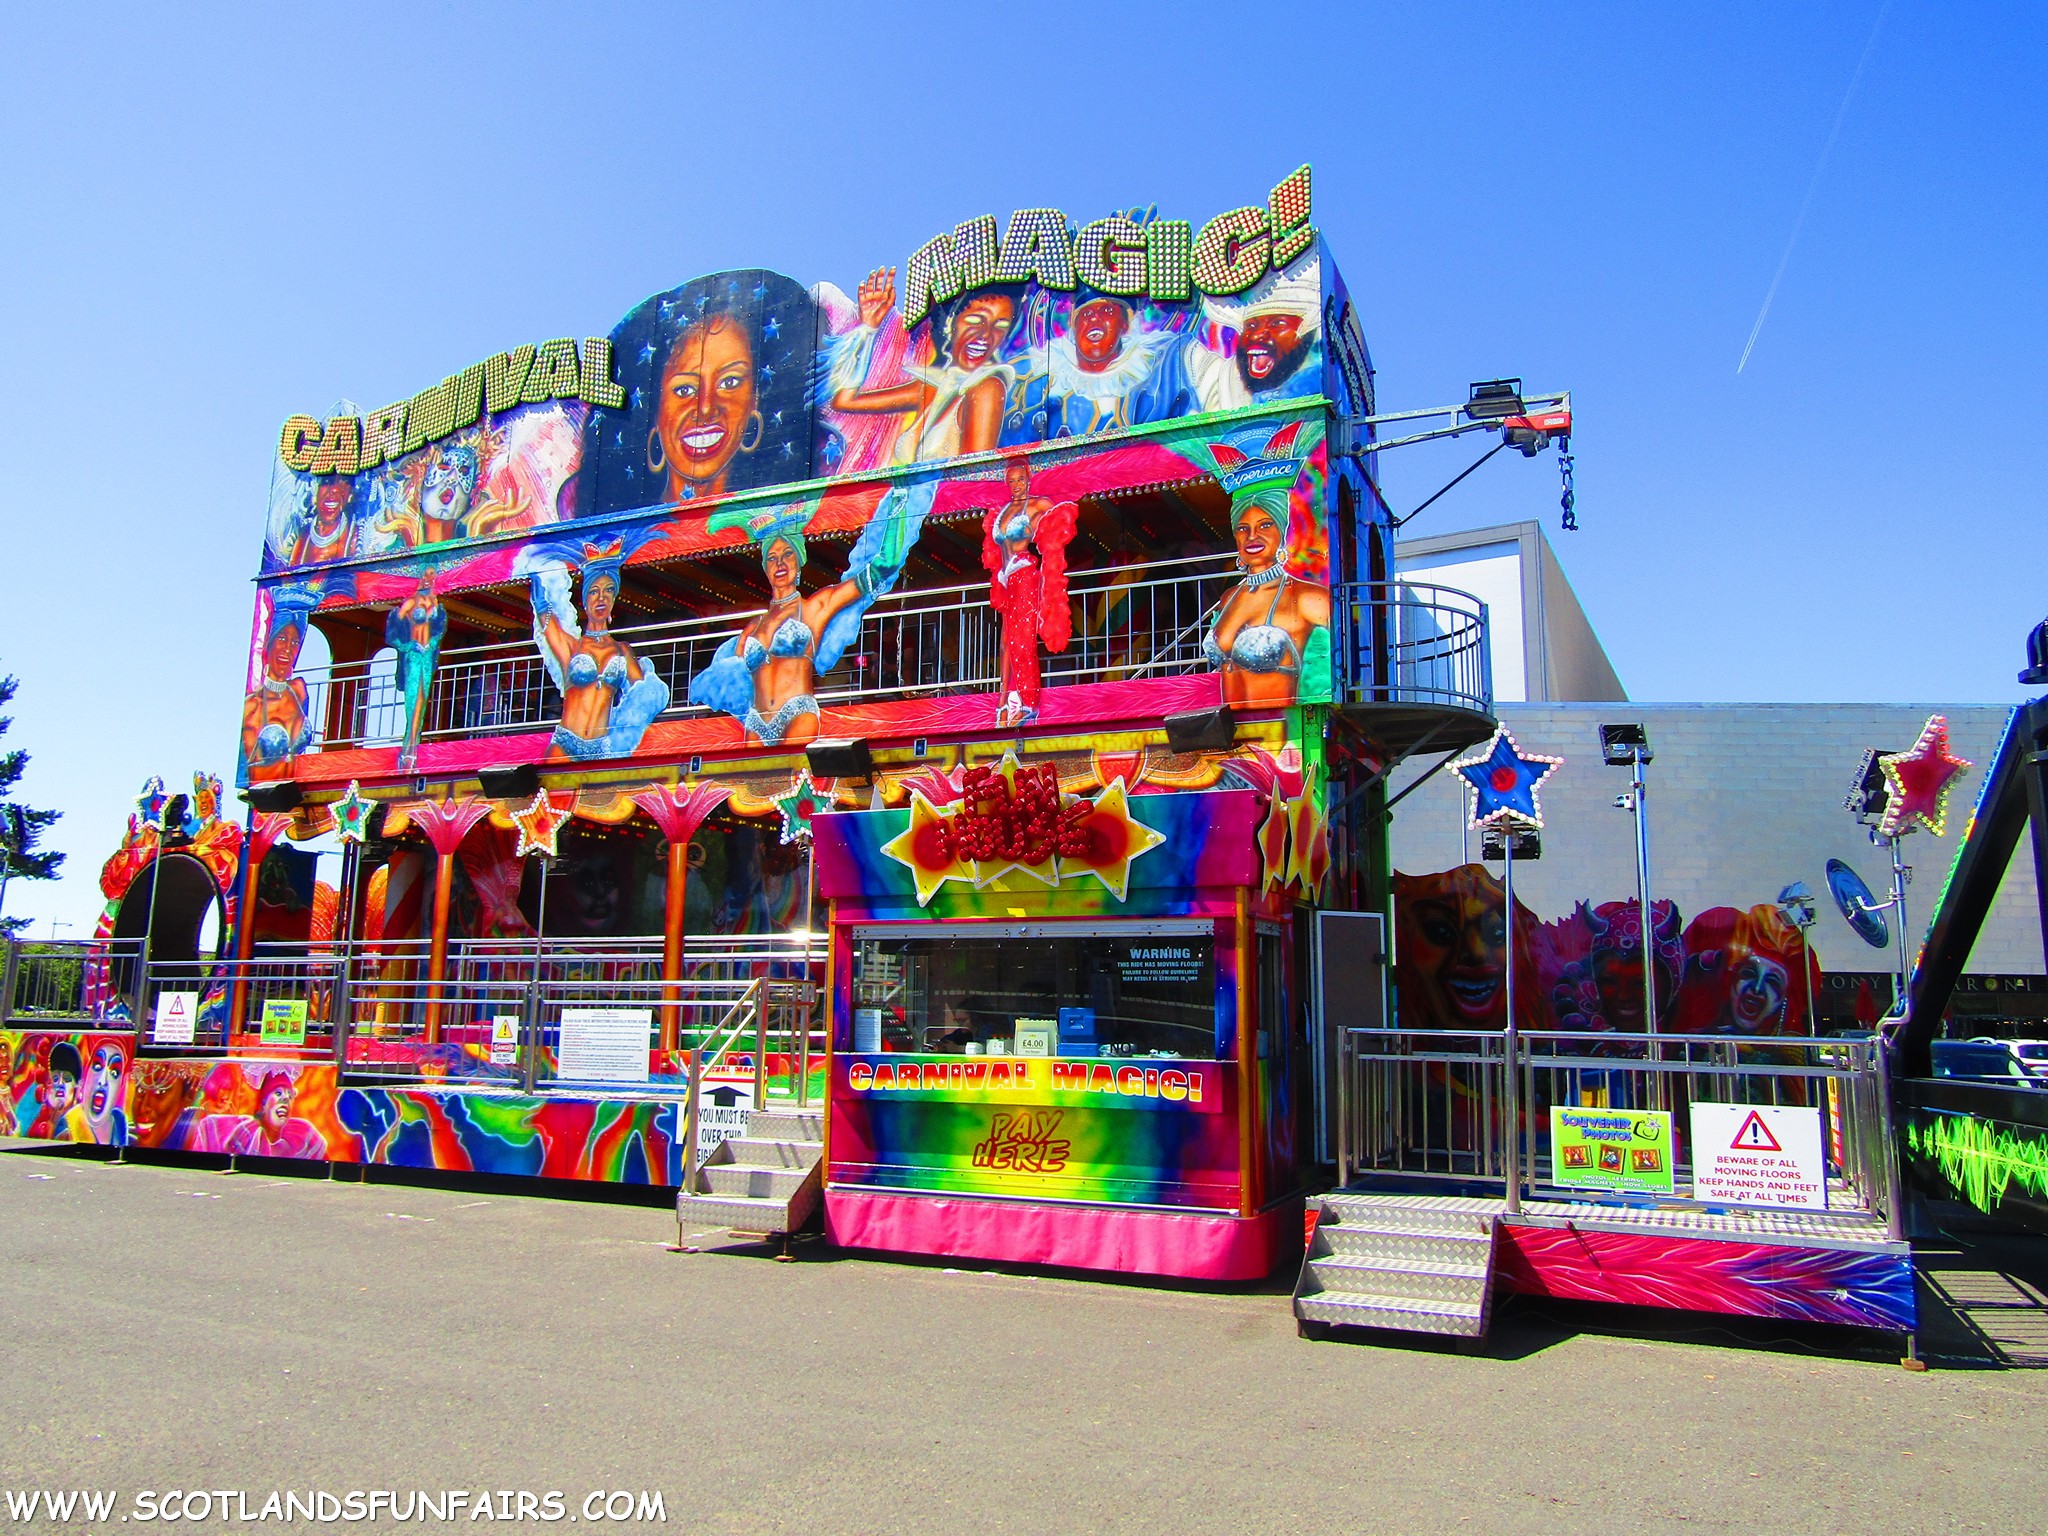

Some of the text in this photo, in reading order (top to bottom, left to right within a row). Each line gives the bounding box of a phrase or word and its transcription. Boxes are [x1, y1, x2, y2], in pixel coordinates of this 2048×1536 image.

[278, 163, 1312, 477] CARNIVAL MAGIC!
[1223, 464, 1292, 491] Experience
[962, 761, 1060, 820] FUN
[935, 799, 1094, 866] HOUSE
[1129, 948, 1191, 959] WARNING
[1022, 1040, 1044, 1048] £4.00
[849, 1062, 1203, 1103] CARNIVAL MAGIC!
[699, 1108, 714, 1123] YOU
[715, 1109, 739, 1125] MUST
[1561, 1113, 1632, 1130] SOUVENIR
[991, 1109, 1065, 1142] PAY
[701, 1128, 722, 1144] OVER
[1581, 1127, 1633, 1142] PHOTOS
[971, 1139, 1071, 1173] HERE
[1716, 1155, 1799, 1168] BEWARE OF ALL
[1714, 1167, 1802, 1180] MOVING FLOORS
[1699, 1177, 1819, 1193] KEEP HANDS AND FEET
[1710, 1189, 1808, 1204] SAFE AT ALL TIMES
